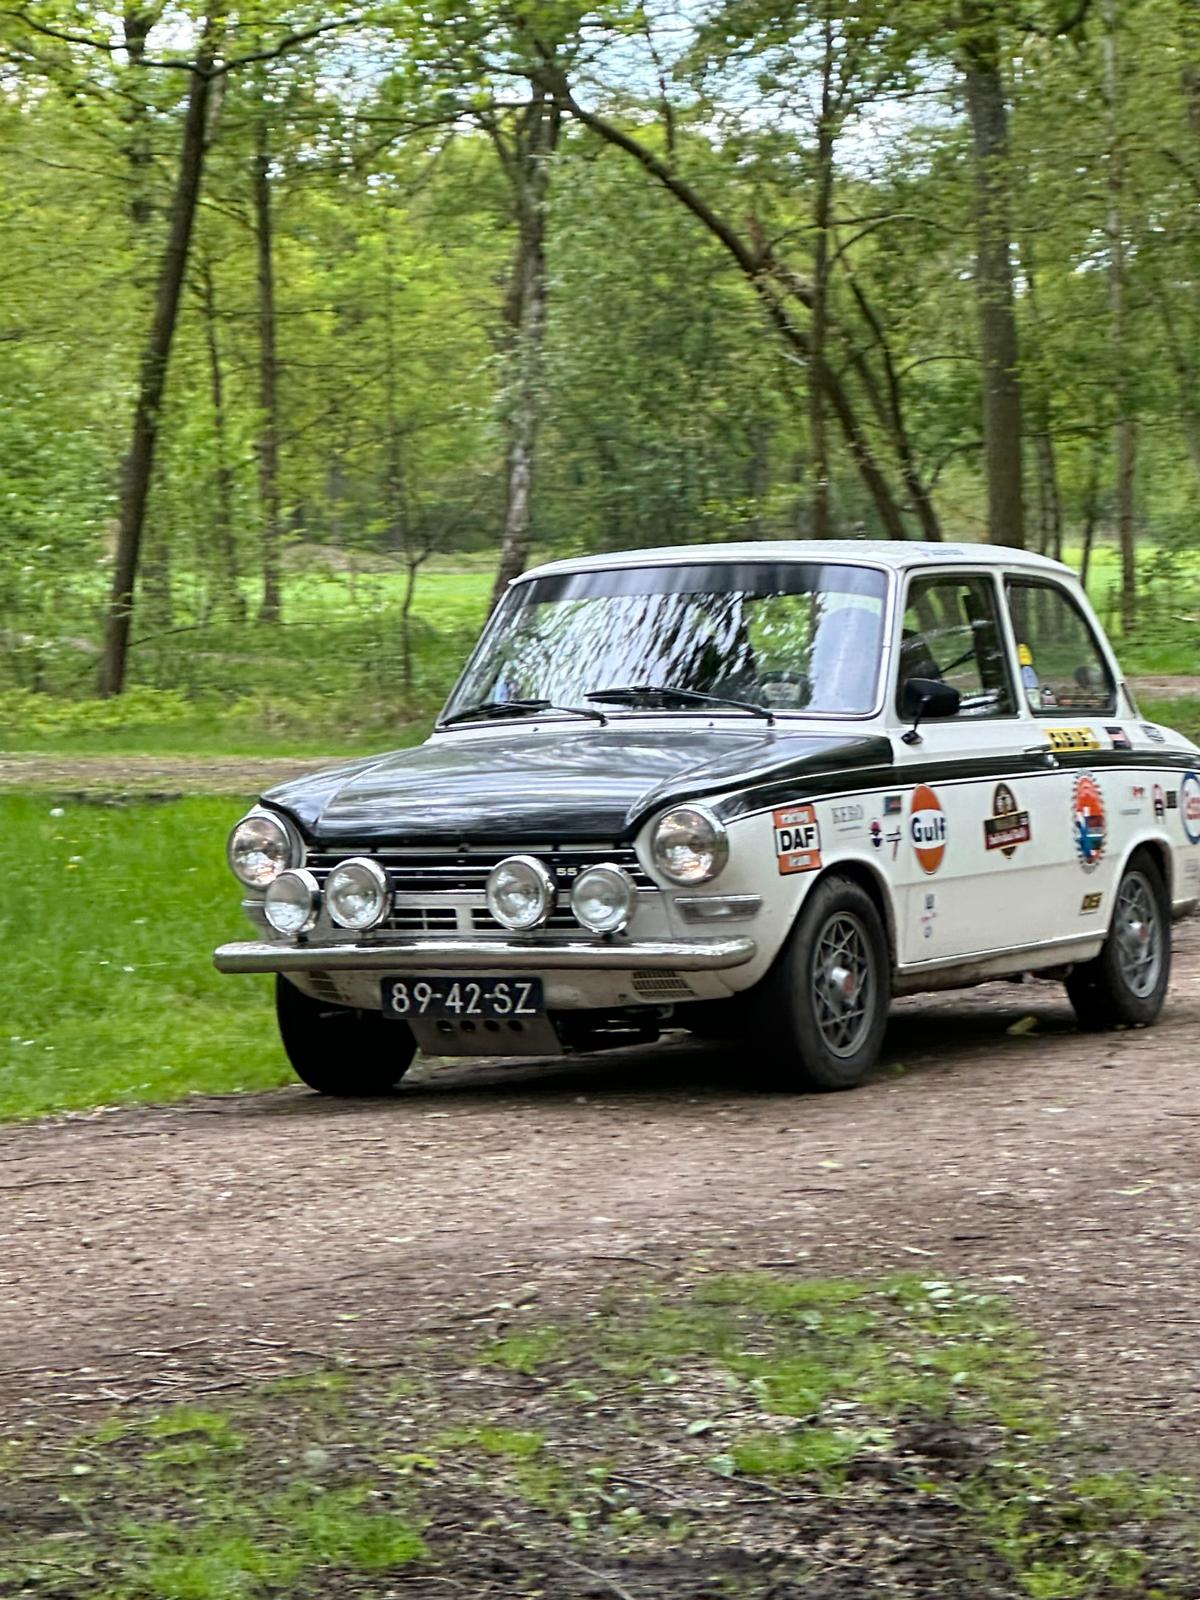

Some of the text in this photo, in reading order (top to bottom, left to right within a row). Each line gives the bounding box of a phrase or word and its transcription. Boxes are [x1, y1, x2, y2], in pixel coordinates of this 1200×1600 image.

[780, 826, 815, 852] DAF
[911, 817, 945, 843] Gulf
[391, 982, 537, 1014] 89-42-SZ
